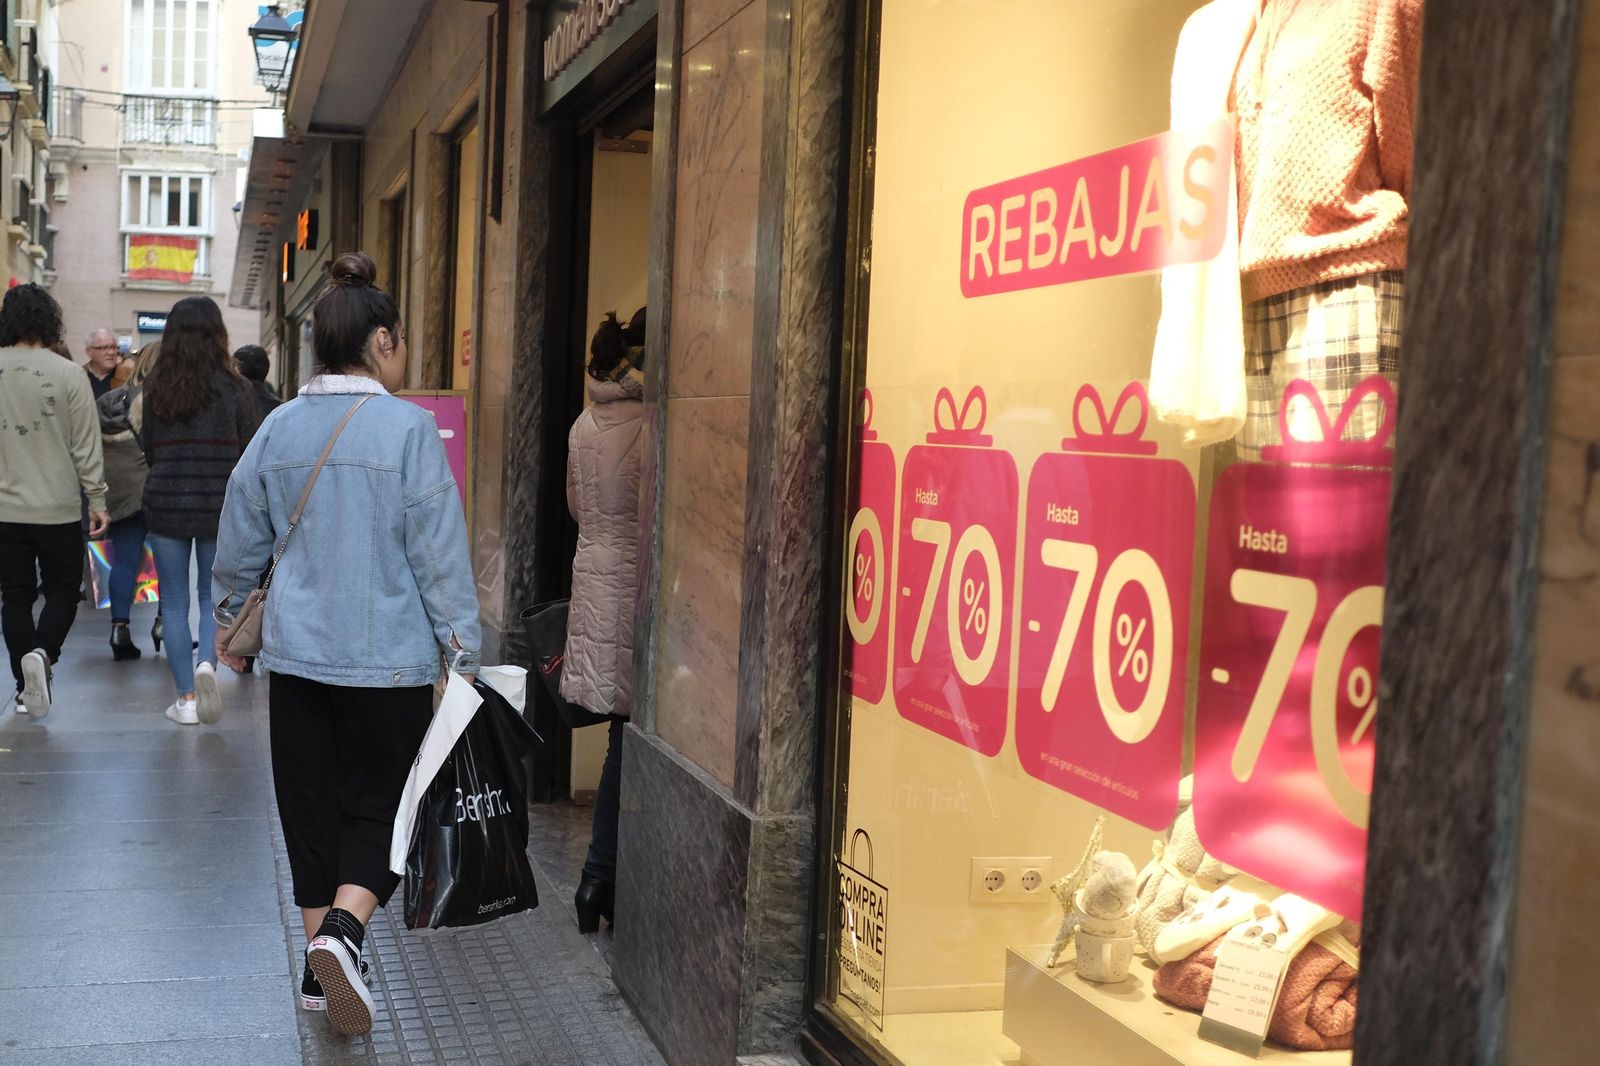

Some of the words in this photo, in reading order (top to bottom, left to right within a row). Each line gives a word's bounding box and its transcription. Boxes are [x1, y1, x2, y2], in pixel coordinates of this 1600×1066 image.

[969, 144, 1217, 281] REBAJAS
[915, 488, 938, 505] Hasta
[1047, 503, 1079, 525] Hasta
[1239, 525, 1288, 553] Hasta
[456, 783, 512, 823] Bersh
[840, 873, 884, 923] COMPRA
[839, 901, 883, 956] ONLINE
